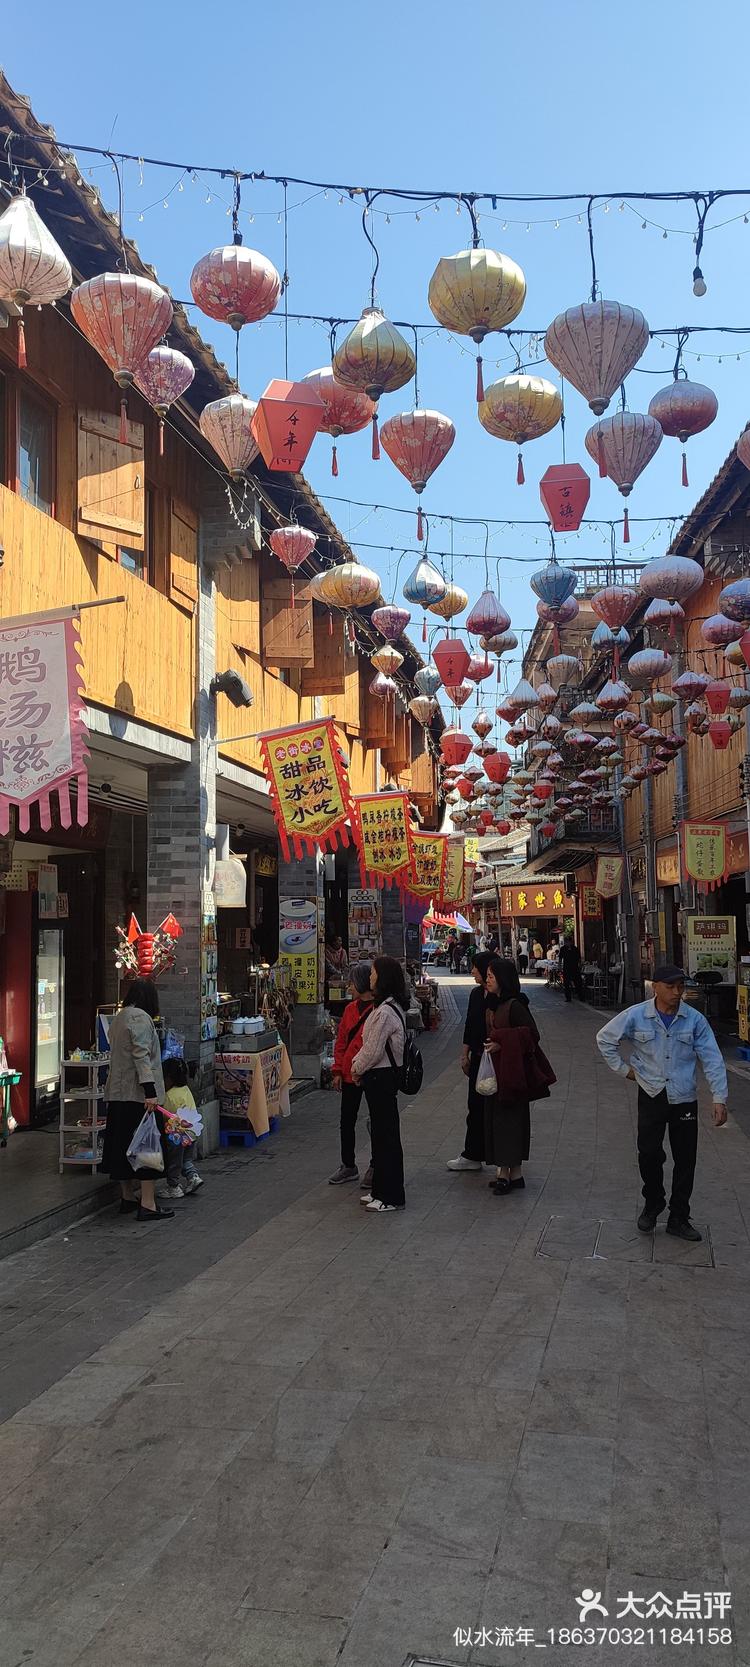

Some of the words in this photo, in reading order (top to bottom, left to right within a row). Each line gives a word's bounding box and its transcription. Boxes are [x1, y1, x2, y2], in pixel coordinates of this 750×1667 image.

[280, 755, 326, 779] 甜品
[285, 776, 334, 801] 冰饮
[290, 799, 338, 823] 小吃
